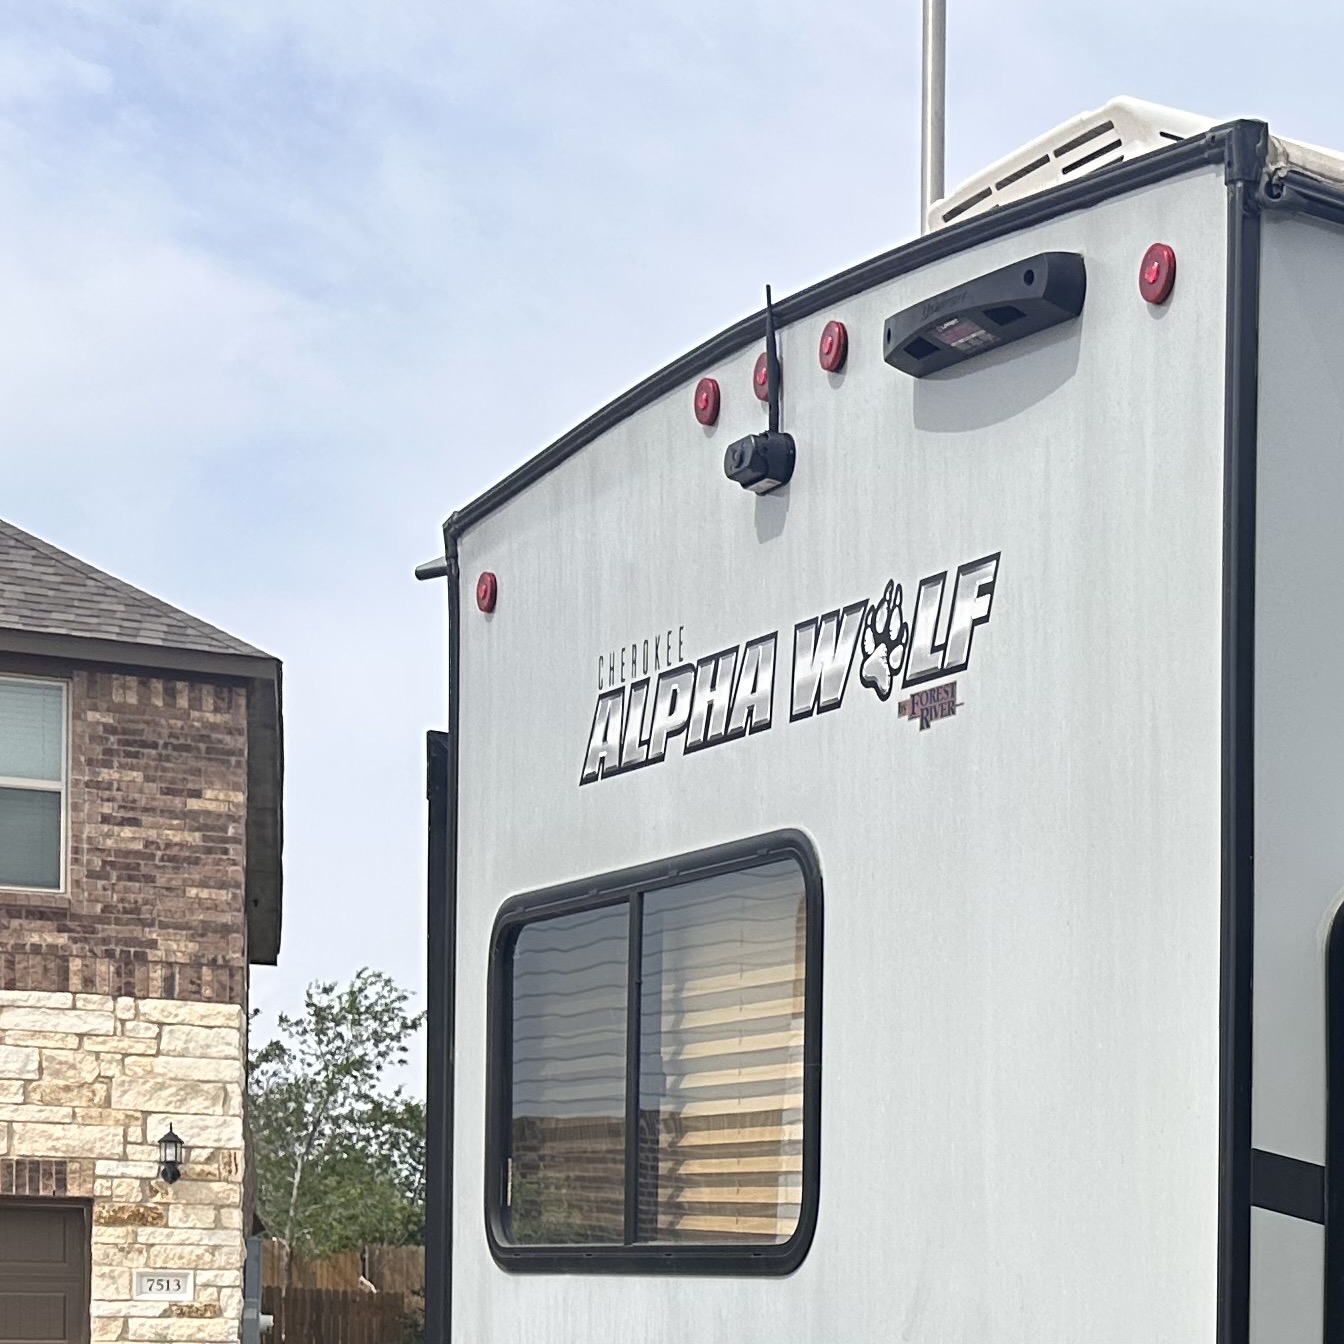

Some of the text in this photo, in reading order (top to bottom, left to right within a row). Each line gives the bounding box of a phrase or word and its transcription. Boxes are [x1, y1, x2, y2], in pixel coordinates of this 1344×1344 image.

[598, 625, 684, 690] CHEROKEE
[579, 631, 778, 786] ALPHA
[909, 682, 957, 717] FOREST
[919, 701, 957, 732] RIVER
[146, 1278, 181, 1292] 7513
